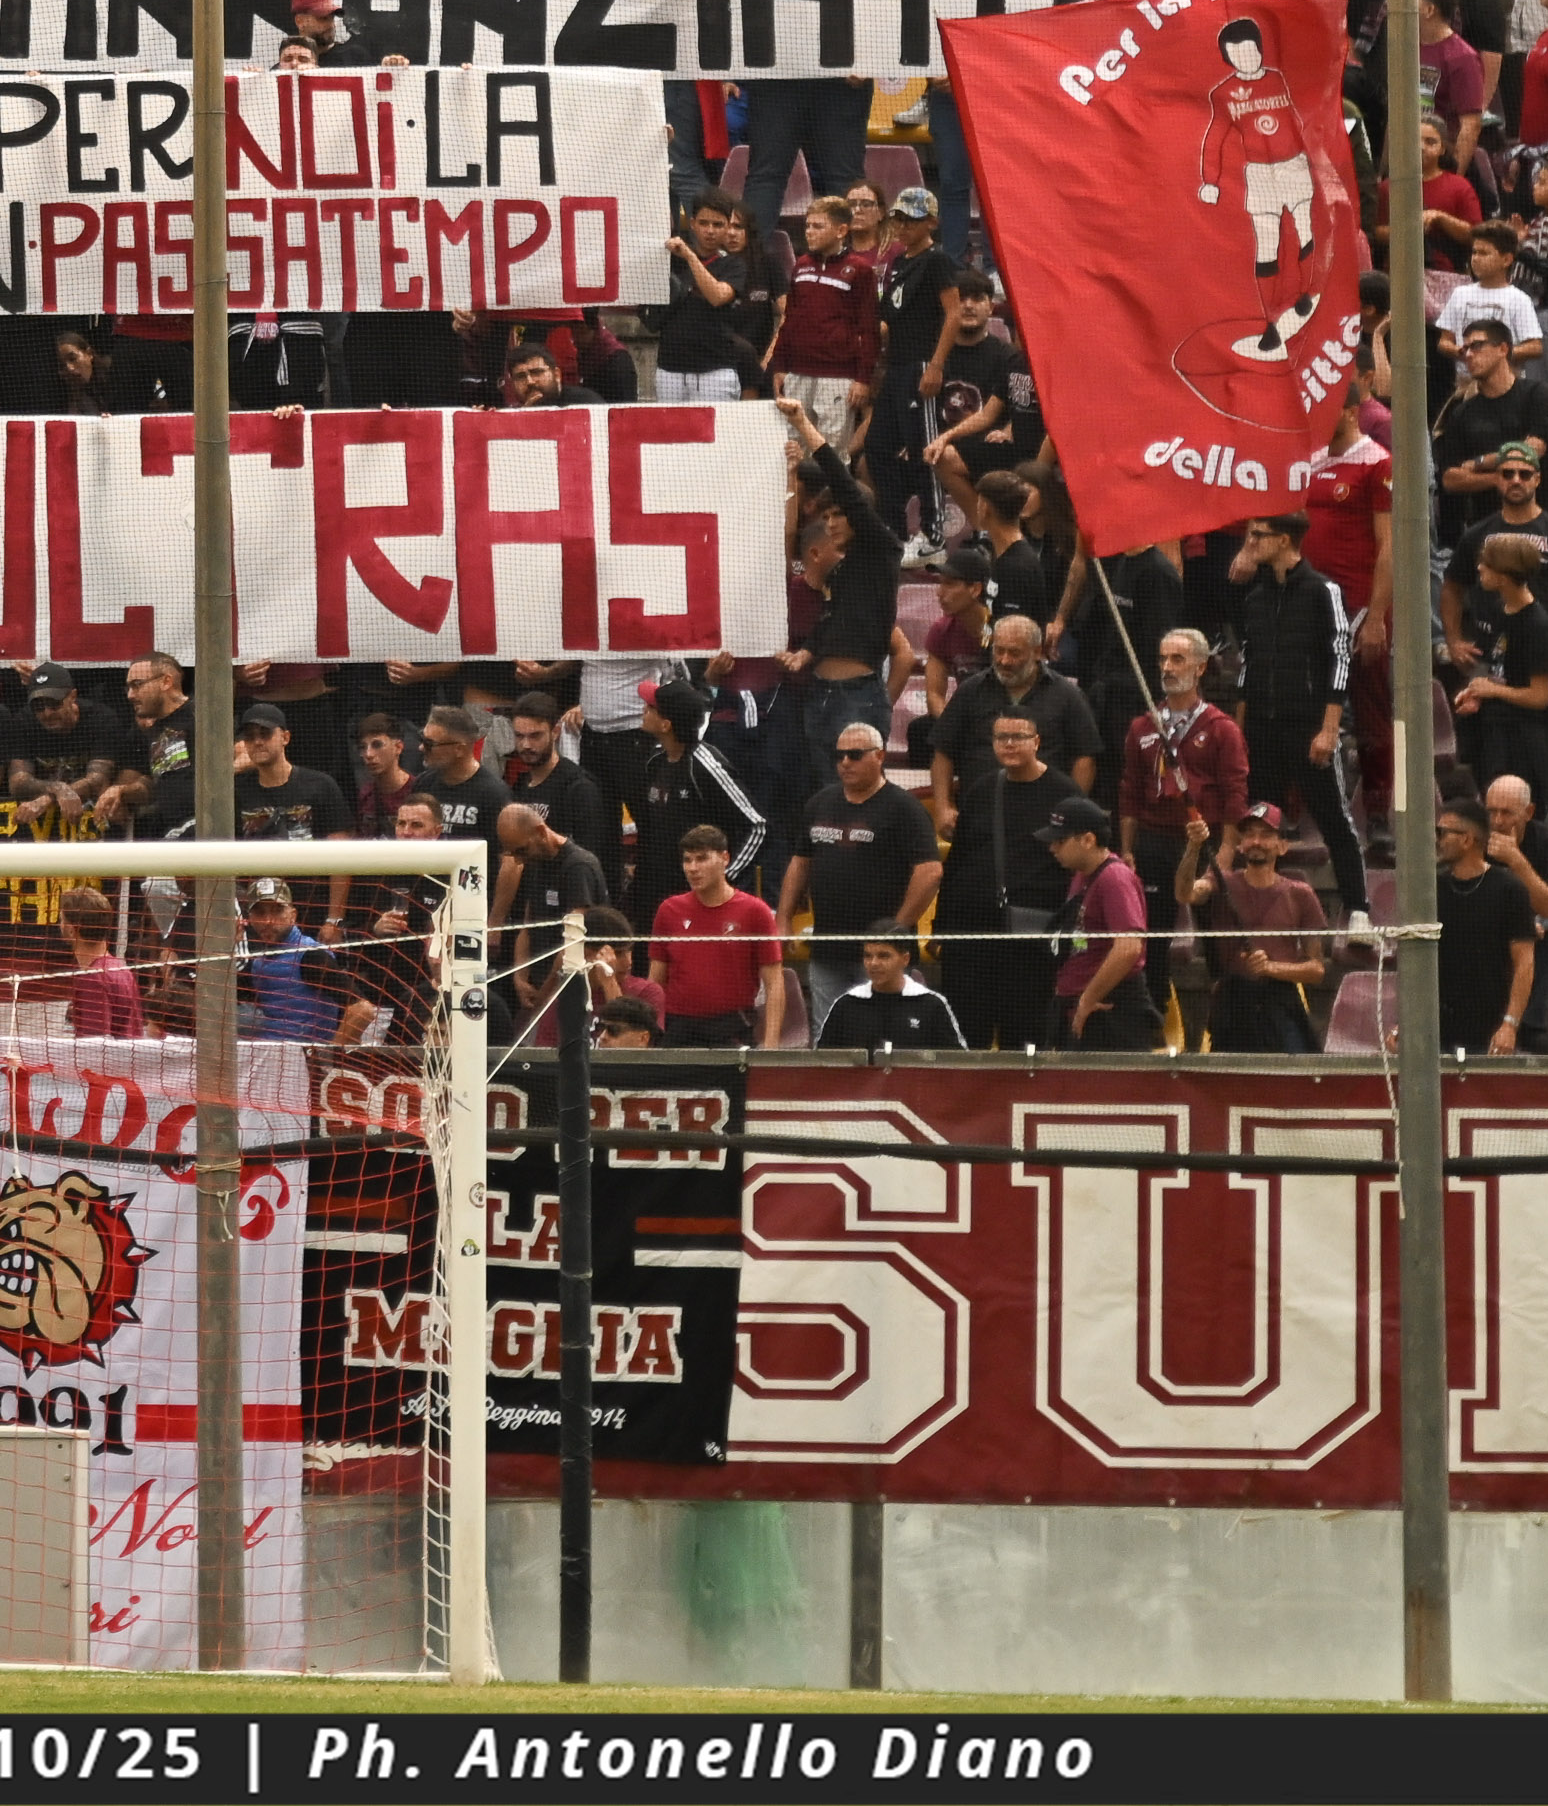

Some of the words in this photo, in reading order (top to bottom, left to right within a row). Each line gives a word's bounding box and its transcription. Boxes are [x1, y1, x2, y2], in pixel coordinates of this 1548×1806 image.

[1058, 27, 1143, 107] Per
[425, 69, 557, 189] LA
[38, 196, 620, 314] PASSATEMPO
[1143, 436, 1271, 494] della
[590, 1405, 629, 1432] 914
[88, 1476, 274, 1560] Nod
